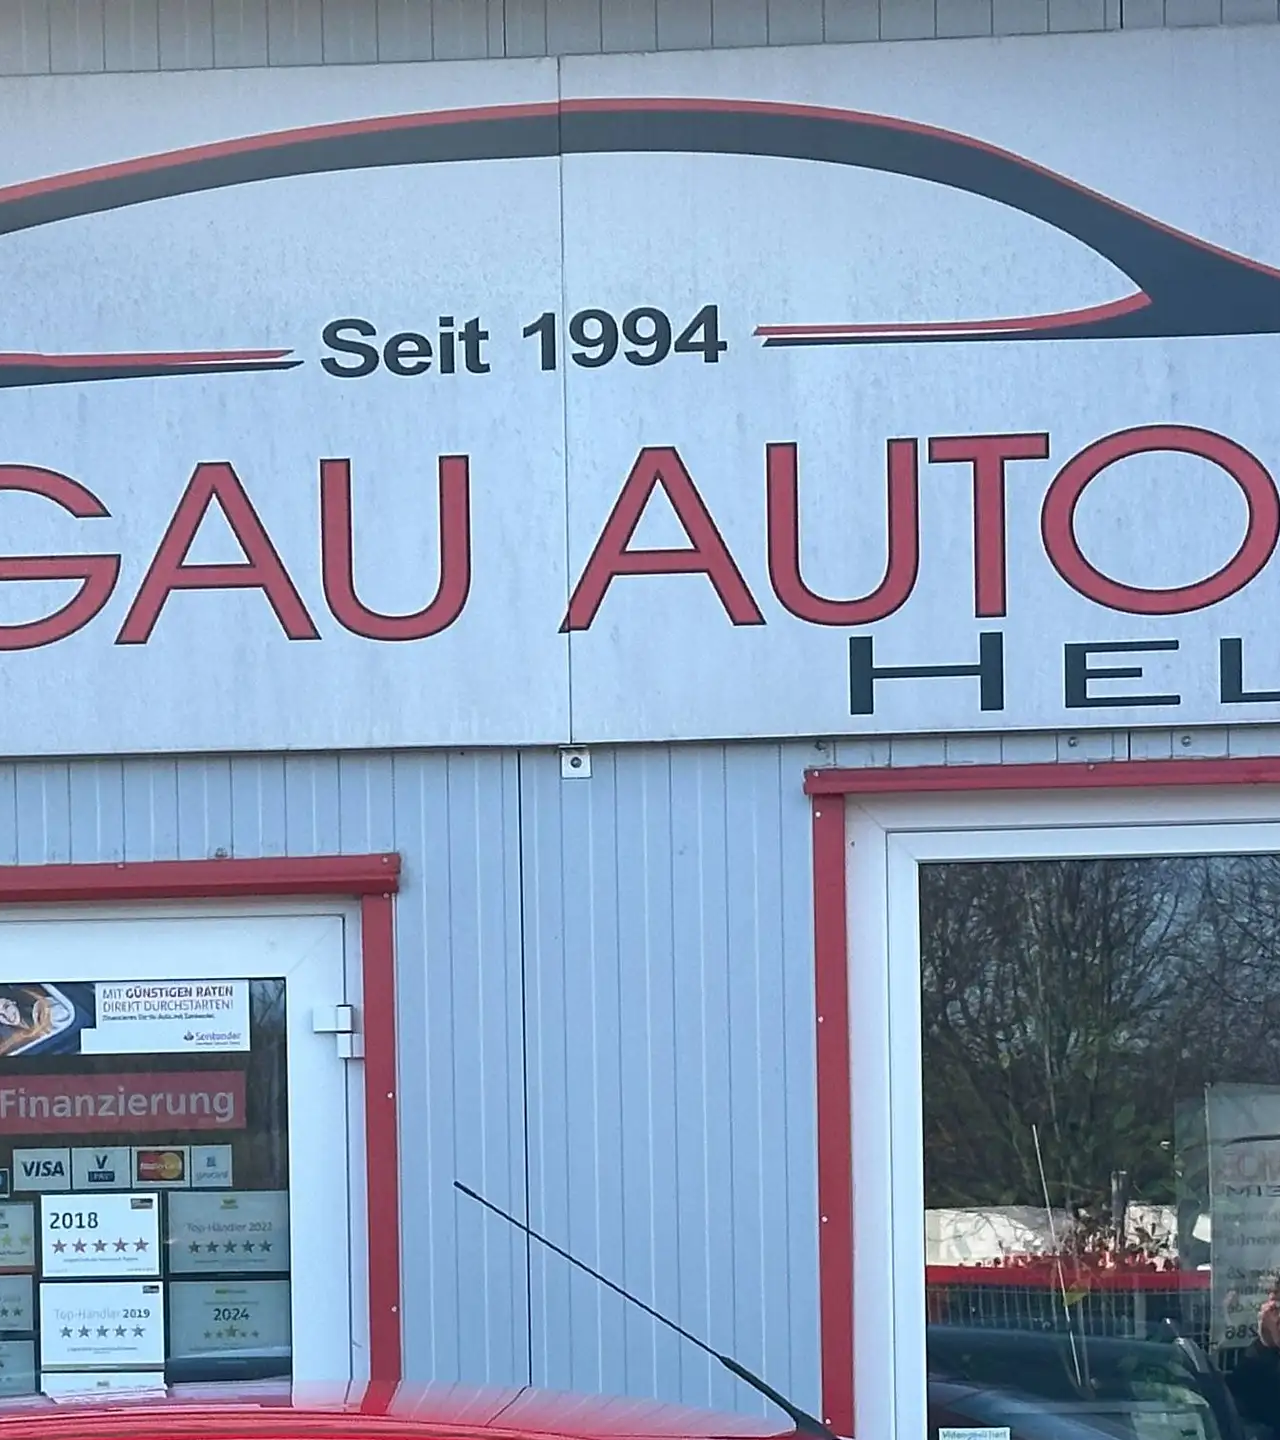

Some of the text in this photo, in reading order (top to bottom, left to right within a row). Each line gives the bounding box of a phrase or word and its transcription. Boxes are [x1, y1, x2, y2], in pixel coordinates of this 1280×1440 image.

[320, 304, 728, 378] Seit 1994
[102, 985, 233, 999] MIT GÜNSTIGEN RATEN
[103, 999, 233, 1013] DIREKT DURCHSTARTEN!
[0, 1086, 234, 1123] Finanzierung
[21, 1160, 65, 1178] VISA
[50, 1212, 98, 1230] 2018
[122, 1308, 151, 1319] 2019
[213, 1308, 250, 1320] 2024
